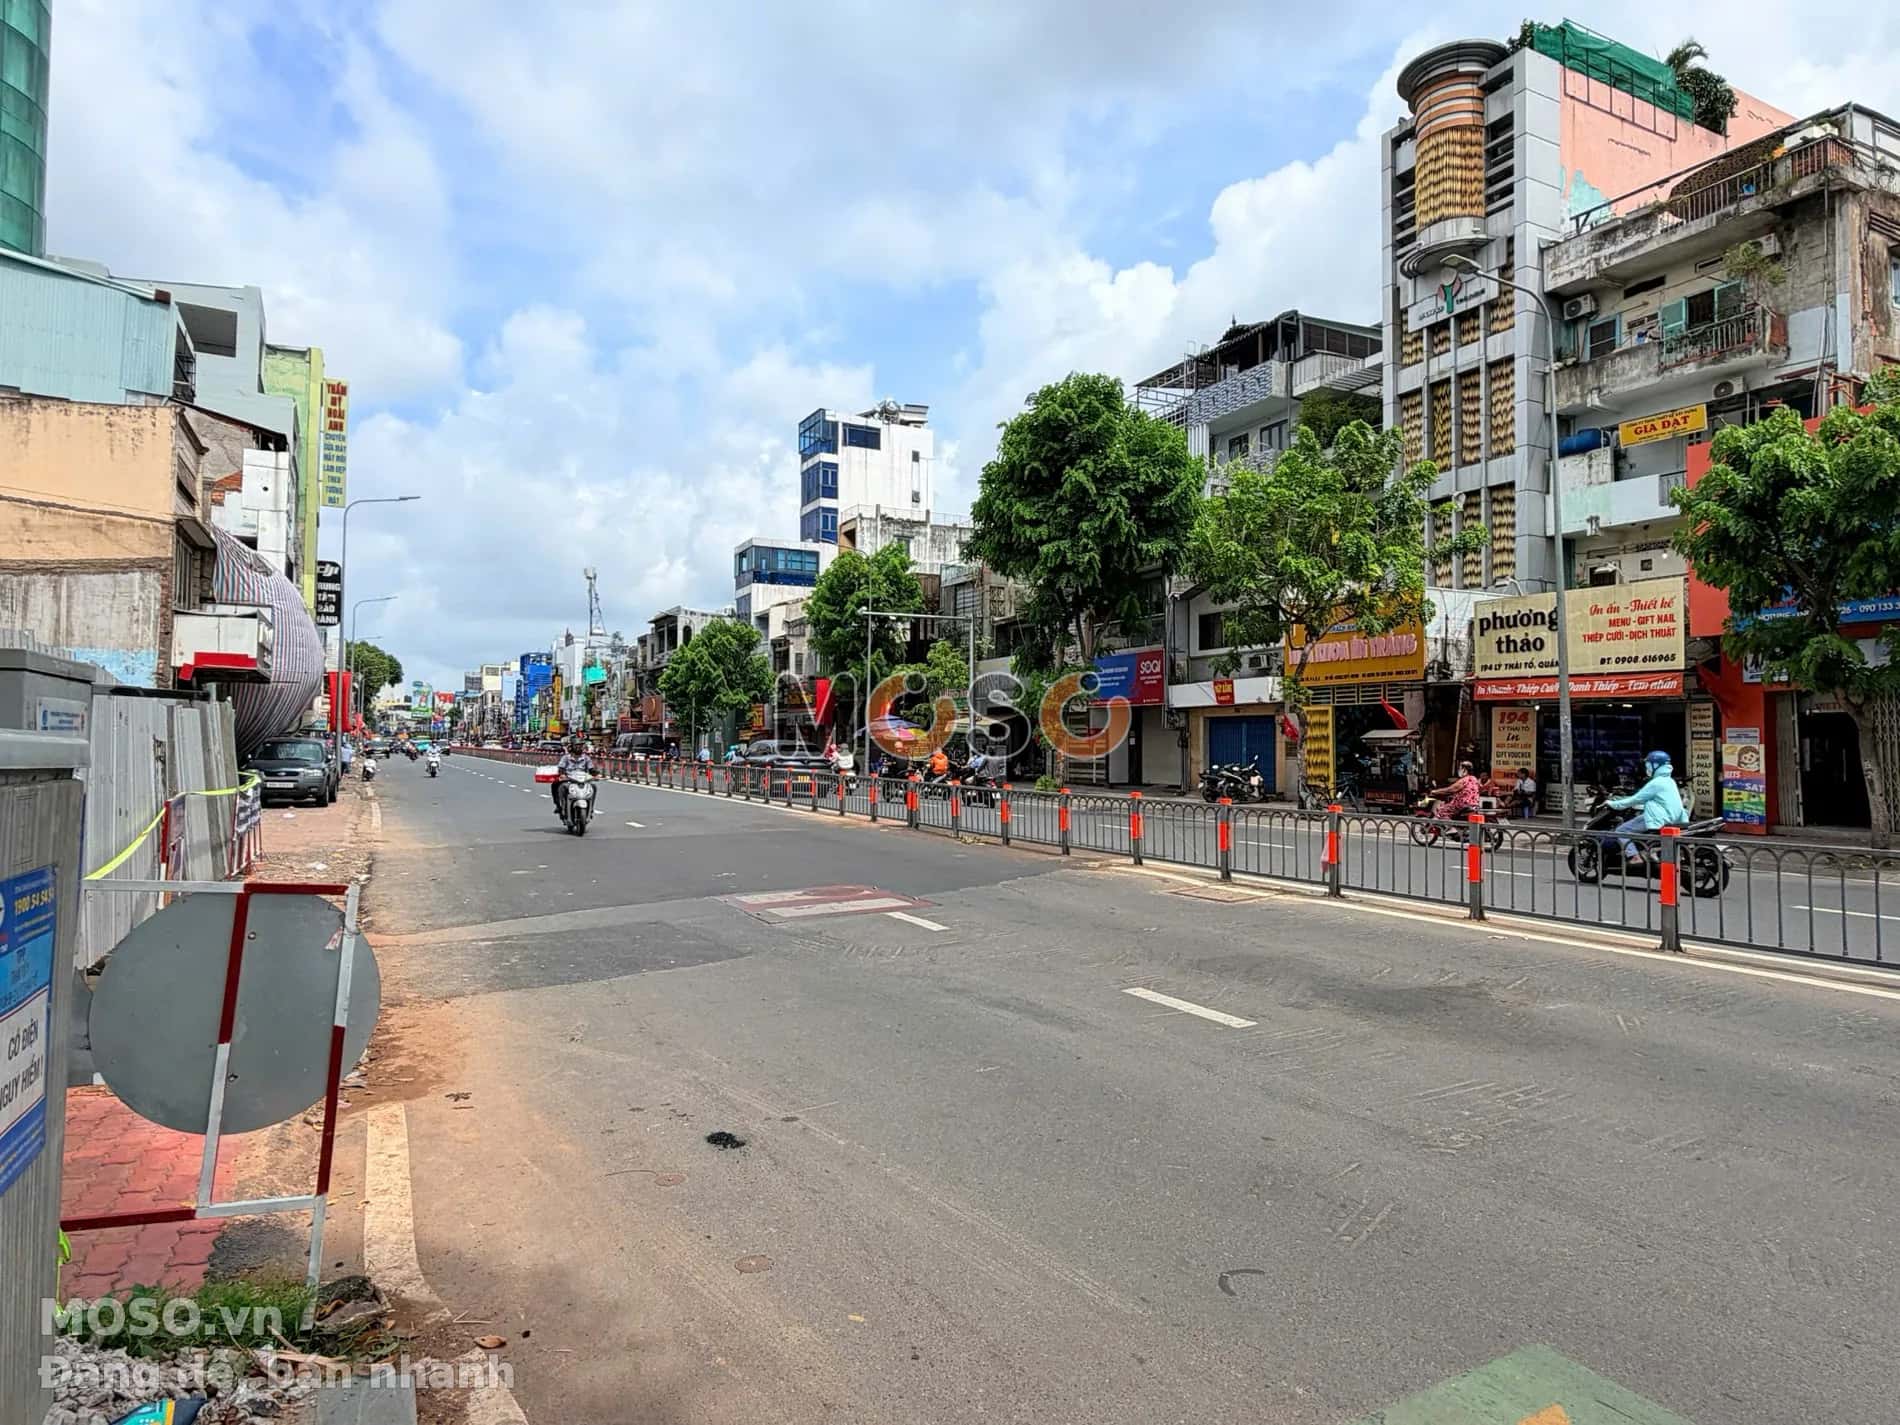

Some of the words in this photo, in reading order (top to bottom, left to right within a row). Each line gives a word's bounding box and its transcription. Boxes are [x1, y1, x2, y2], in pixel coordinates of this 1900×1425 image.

[1479, 606, 1559, 637] phương
[1608, 617, 1631, 628] MENU
[1637, 614, 1655, 625] GIFT
[1496, 632, 1545, 654] thảo
[1499, 711, 1530, 725] 194
[8, 1027, 20, 1061] CÓ
[21, 1017, 39, 1052] ĐIỆN
